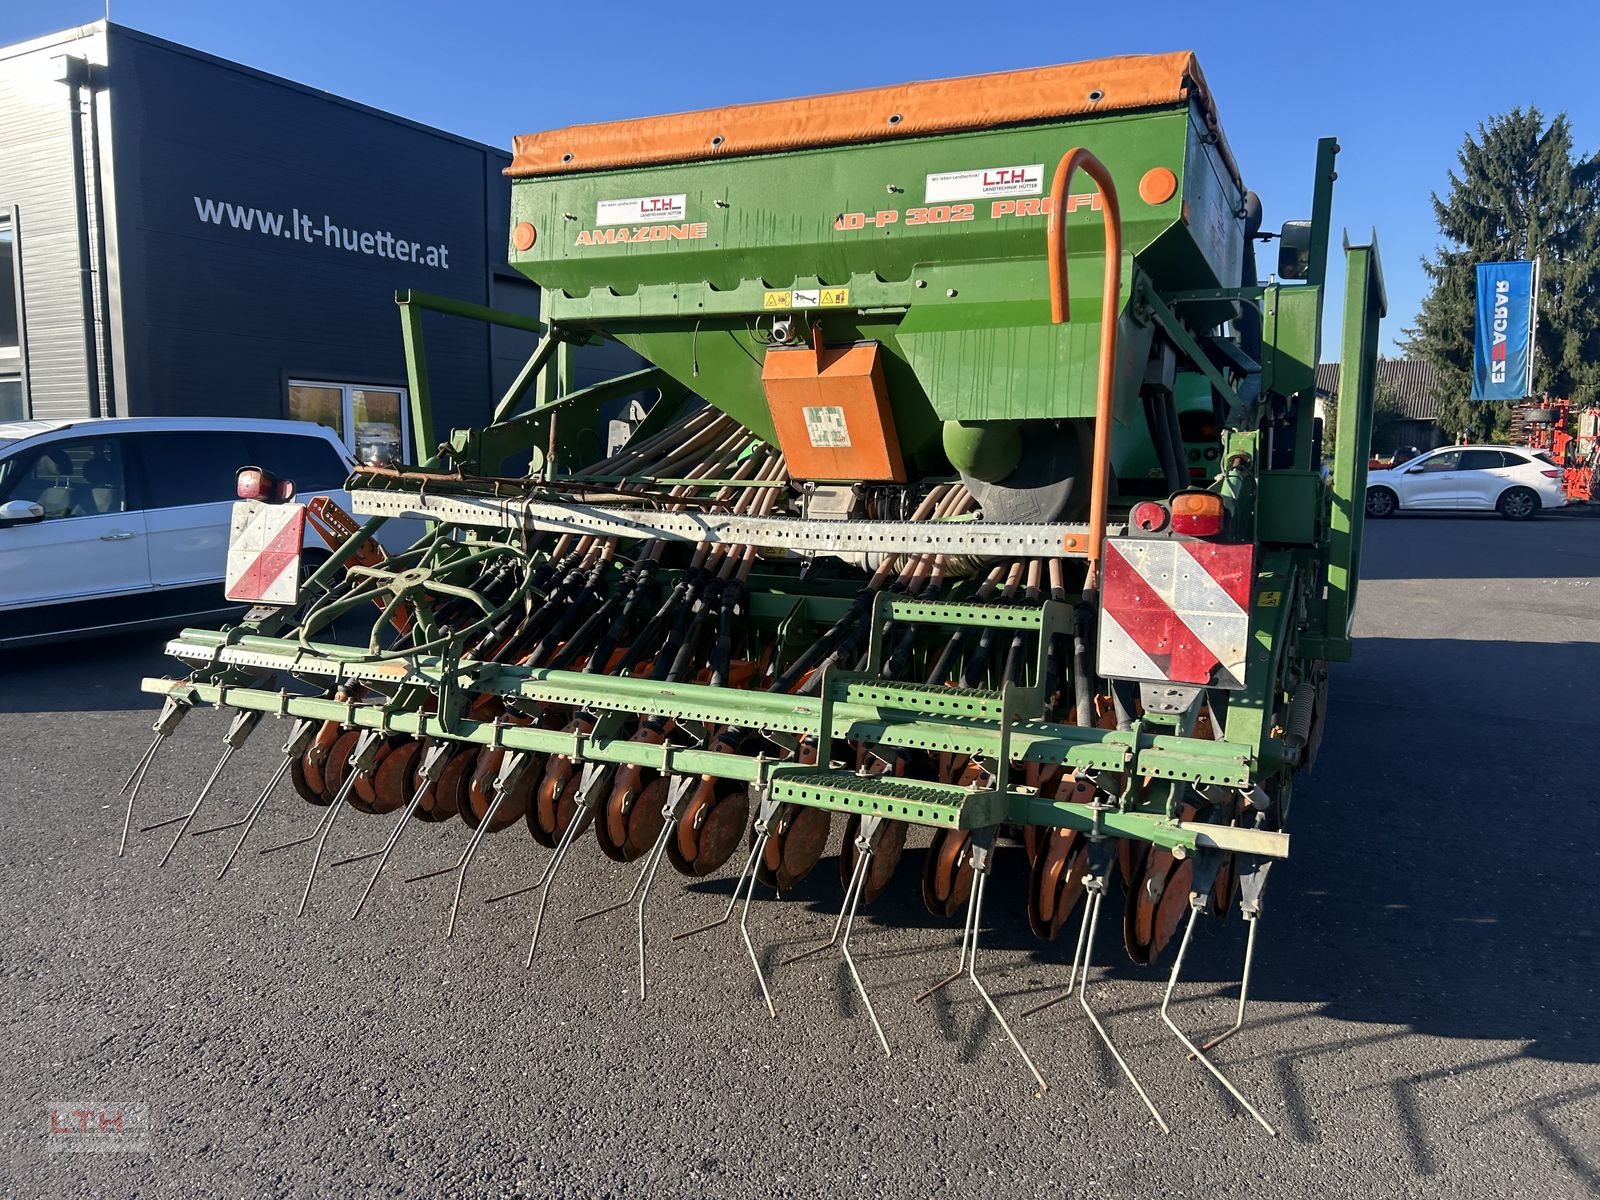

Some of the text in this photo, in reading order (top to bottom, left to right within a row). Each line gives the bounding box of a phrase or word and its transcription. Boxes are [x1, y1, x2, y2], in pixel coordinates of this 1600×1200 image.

[982, 185, 1018, 193] LANDTECHNIK
[905, 203, 975, 226] 302
[193, 196, 449, 269] www.lt-huetter.at
[574, 222, 708, 247] AMAZONE
